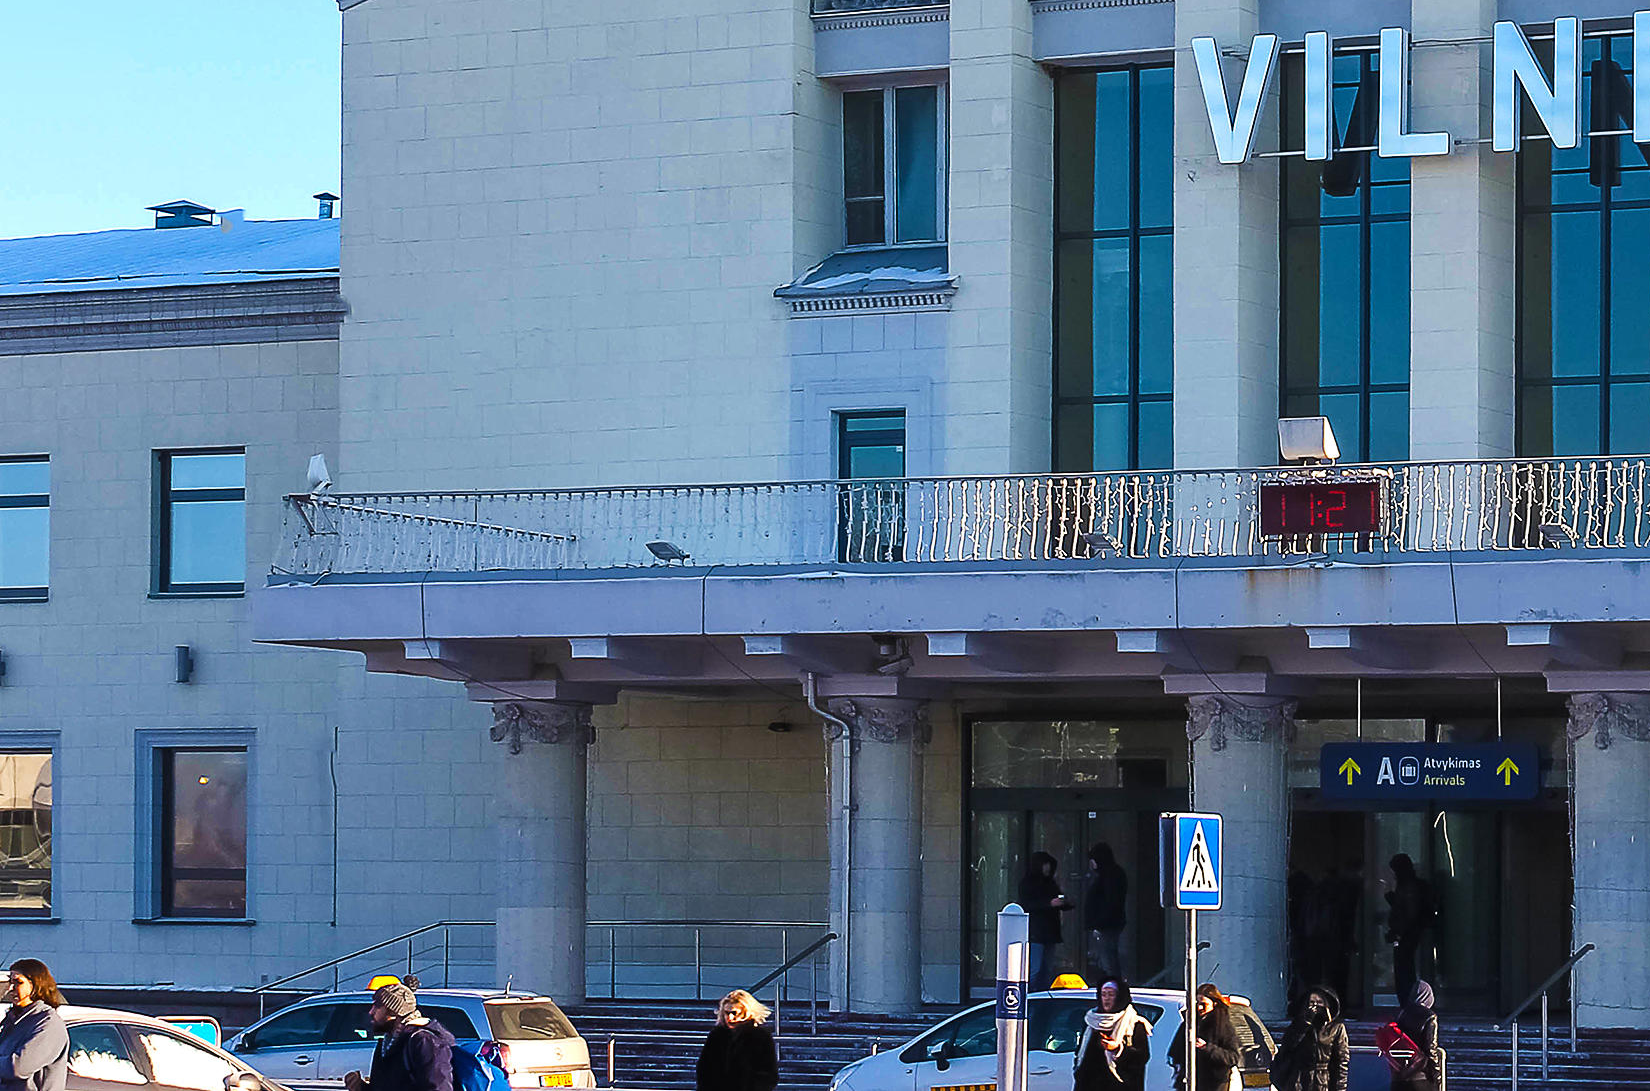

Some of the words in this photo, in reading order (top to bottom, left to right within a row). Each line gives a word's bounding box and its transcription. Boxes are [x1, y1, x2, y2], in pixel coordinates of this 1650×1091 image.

[1281, 490, 1375, 527] 11:21
[1376, 756, 1396, 785] A
[1423, 757, 1481, 771] Atvykimas
[1423, 774, 1466, 786] Arrivals
